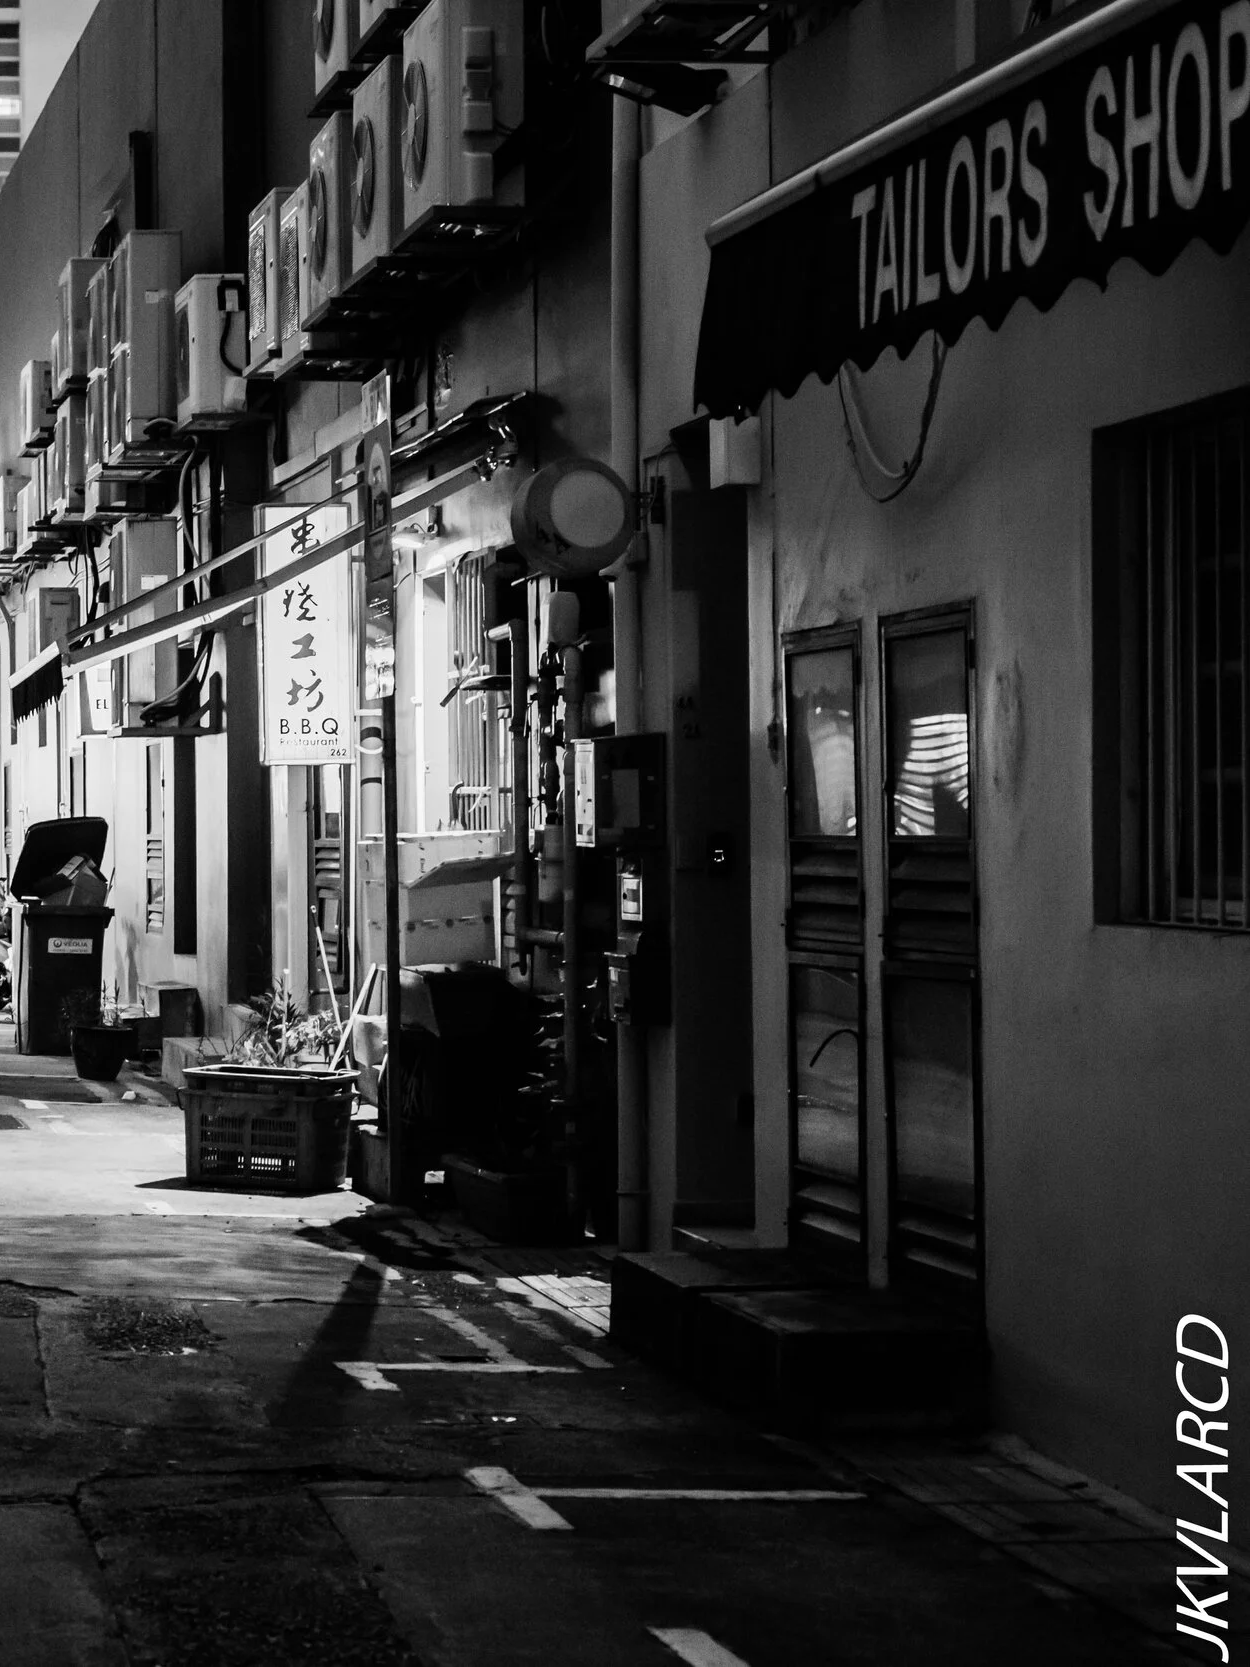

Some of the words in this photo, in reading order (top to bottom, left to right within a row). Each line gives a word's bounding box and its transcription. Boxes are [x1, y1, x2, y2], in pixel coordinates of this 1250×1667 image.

[851, 98, 1049, 330] TAILORS
[1082, 0, 1250, 243] SHOP
[280, 717, 339, 735] B.B.Q
[330, 748, 347, 757] 262
